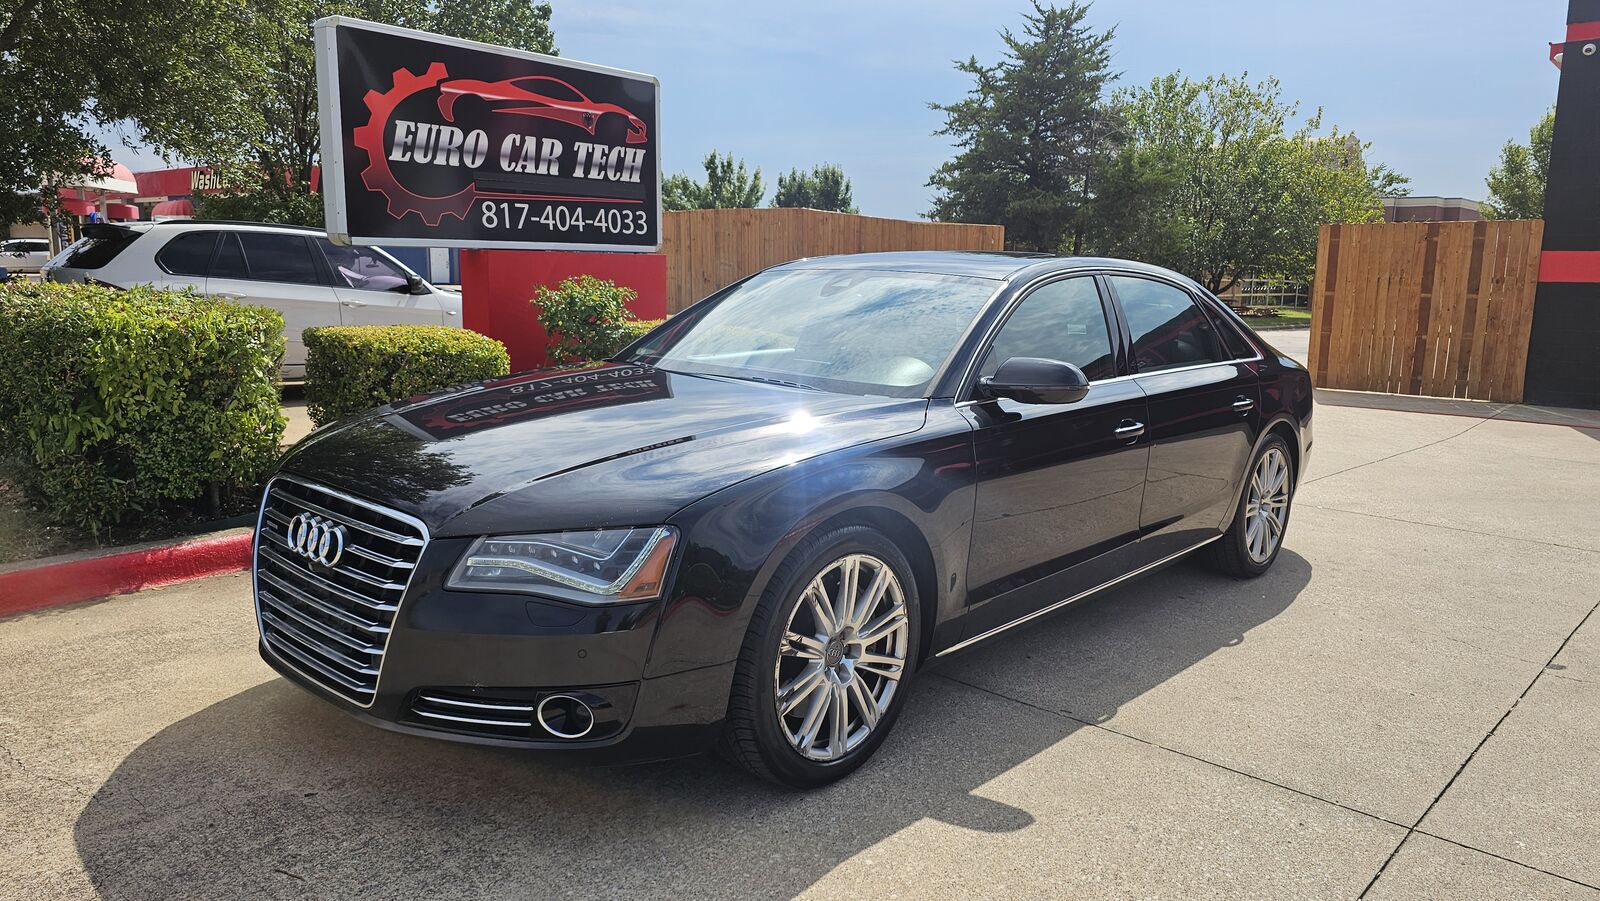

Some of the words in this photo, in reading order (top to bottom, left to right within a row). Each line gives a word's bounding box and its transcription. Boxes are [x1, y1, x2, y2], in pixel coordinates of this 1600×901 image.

[388, 119, 489, 169] EURO
[499, 133, 563, 176] CAR
[572, 141, 647, 183] TECH
[481, 200, 648, 235] 817-404-4033
